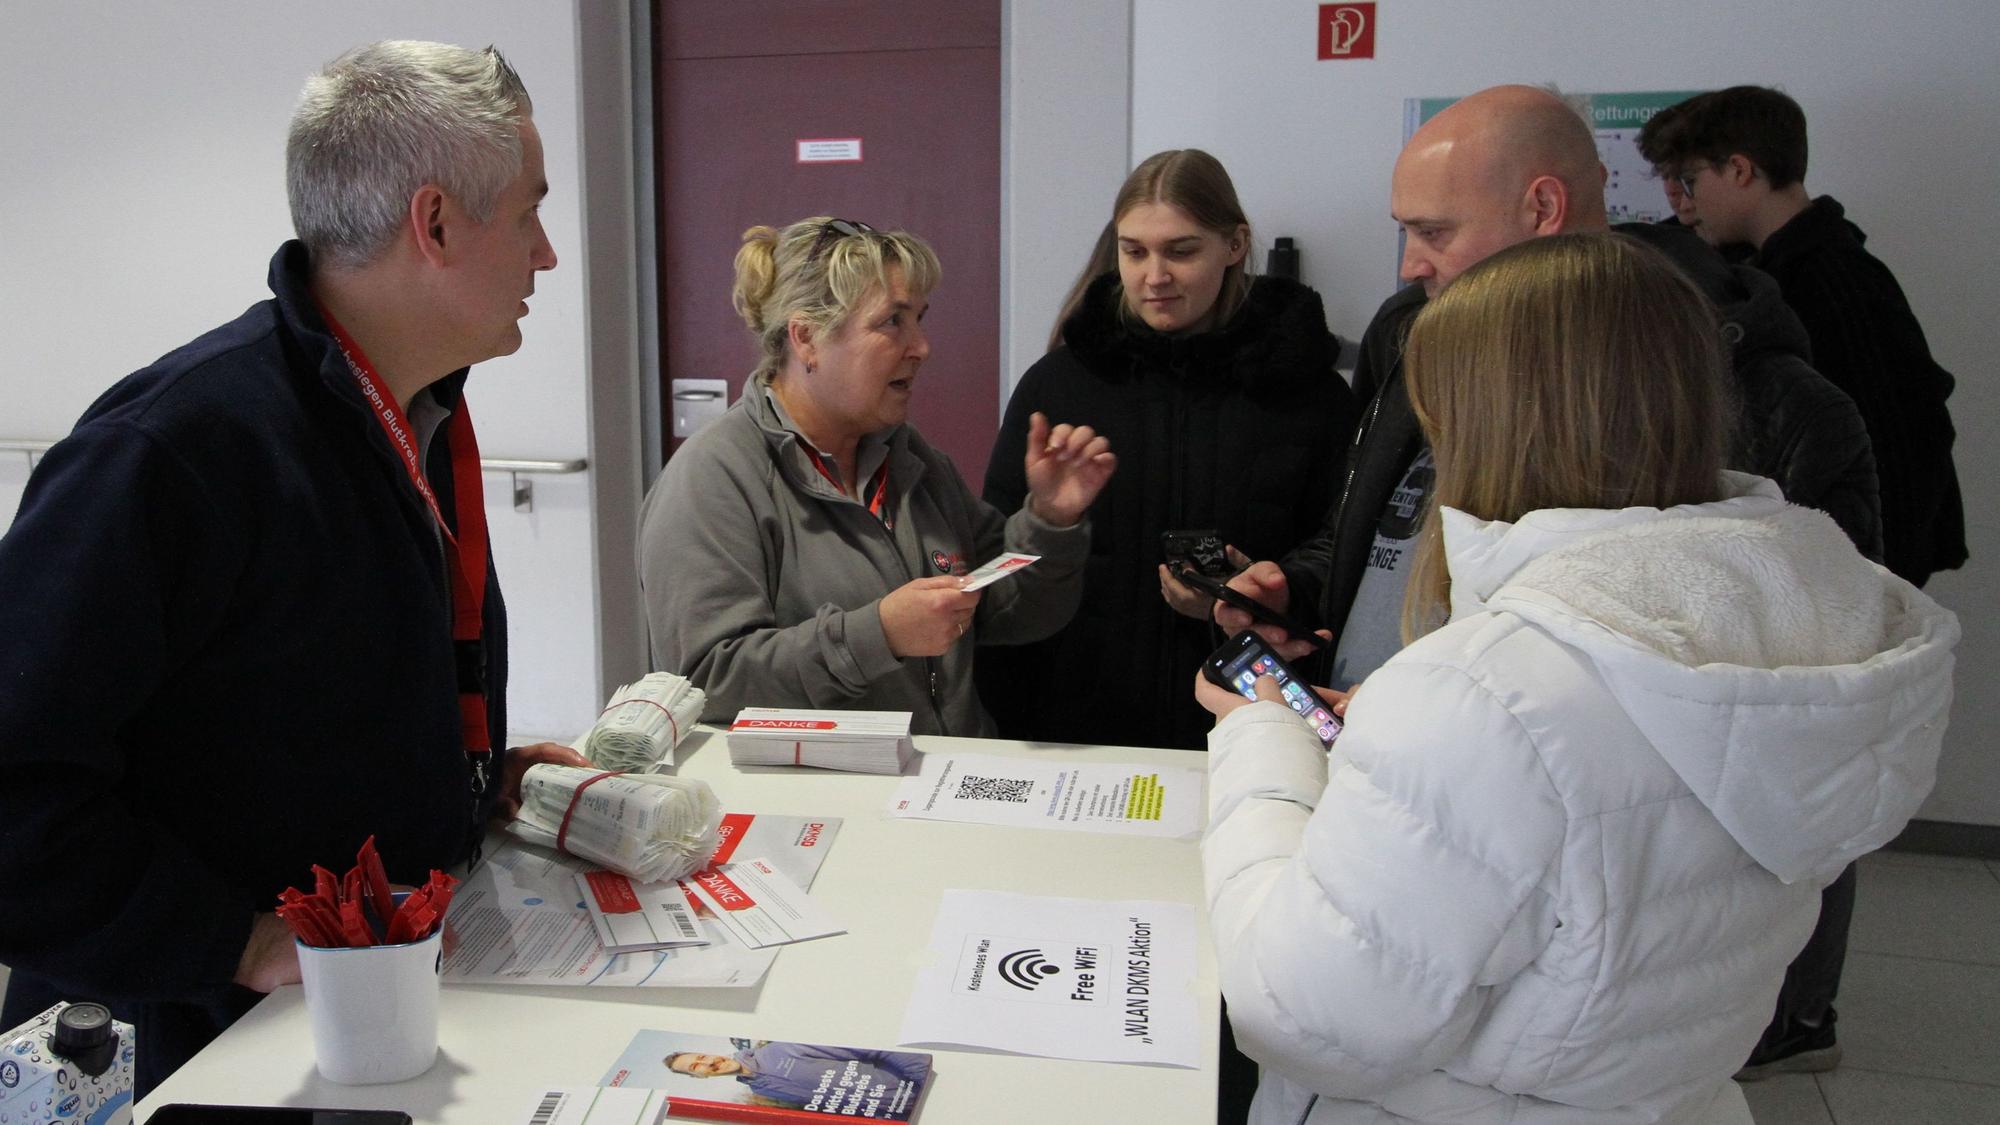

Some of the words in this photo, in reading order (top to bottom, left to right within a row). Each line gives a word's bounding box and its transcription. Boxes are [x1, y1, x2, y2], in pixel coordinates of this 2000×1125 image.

[1587, 105, 1663, 123] Rettungs
[749, 720, 817, 729] DANKE
[701, 872, 744, 904] DANKE
[1074, 947, 1098, 970] WiFi
[967, 953, 988, 991] Kostenloses
[1126, 960, 1150, 995] DKMS
[1071, 973, 1095, 1001] Free
[812, 1069, 836, 1094] beste
[822, 1087, 847, 1114] Mittel
[839, 1060, 859, 1088] gegen
[869, 1084, 887, 1098] Sie
[803, 1094, 824, 1112] Das
[841, 1074, 872, 1116] Blutkrebs
[861, 1098, 880, 1118] sind
